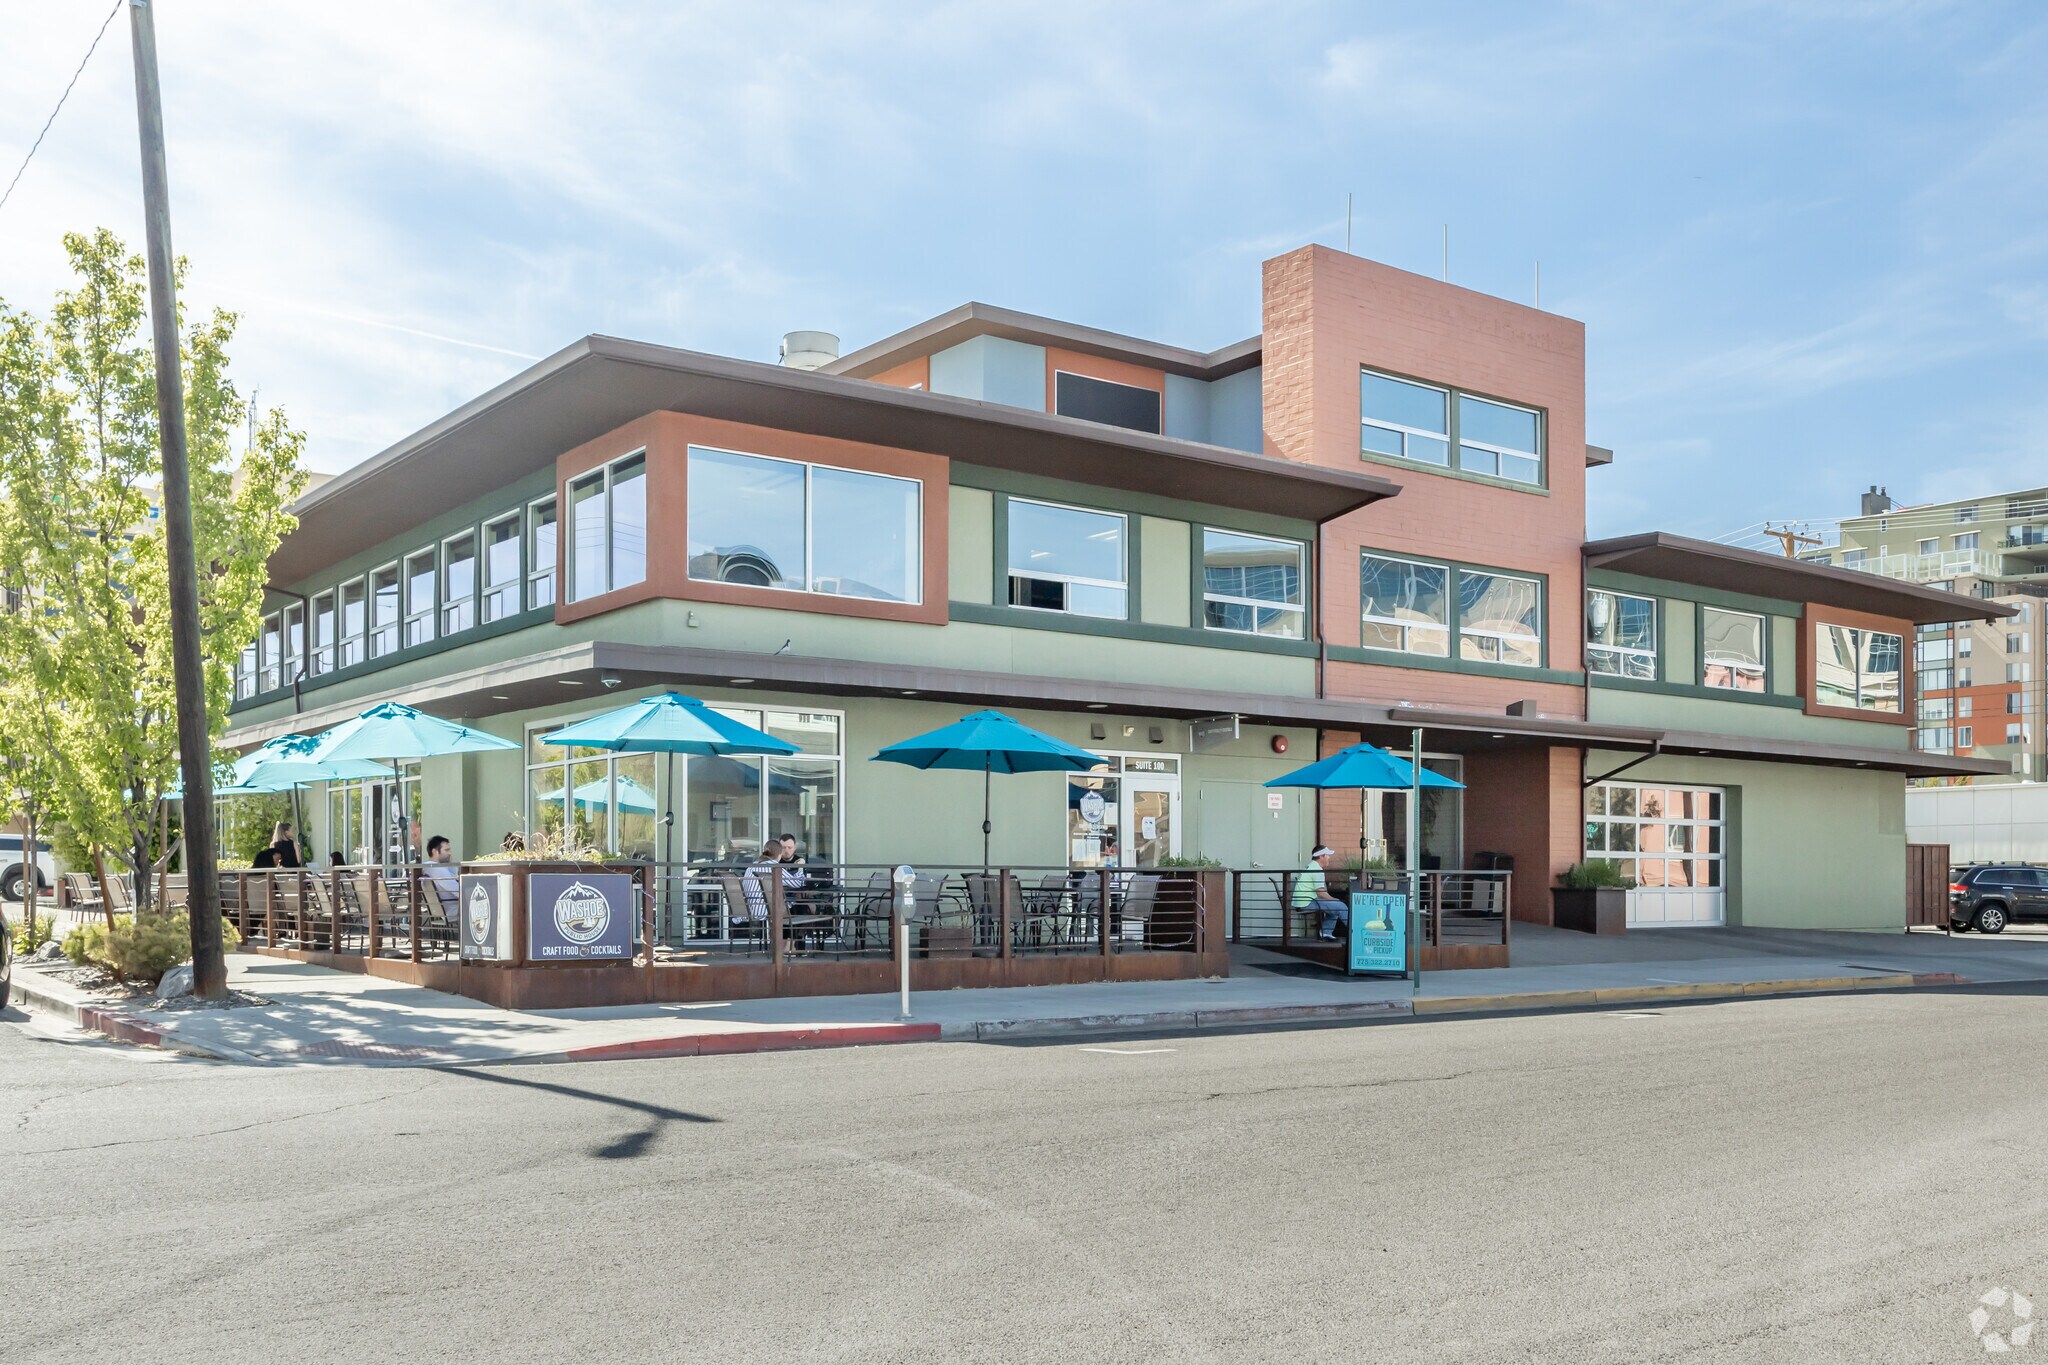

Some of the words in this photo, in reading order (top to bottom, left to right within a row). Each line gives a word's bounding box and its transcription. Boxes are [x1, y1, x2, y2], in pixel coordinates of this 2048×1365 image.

[1135, 761, 1152, 770] SUITE
[1153, 761, 1165, 771] 100
[1354, 894, 1380, 906] WE'RE
[1383, 895, 1405, 907] OPEN
[557, 899, 605, 922] WASHOE
[564, 926, 583, 939] PUBLIC
[584, 927, 602, 939] HOUSE
[1363, 937, 1394, 947] CURBSIDE
[542, 946, 562, 956] CRAFT
[563, 946, 579, 955] FOOD
[591, 945, 622, 955] COCKTAILS
[1373, 947, 1393, 955] PICKUP
